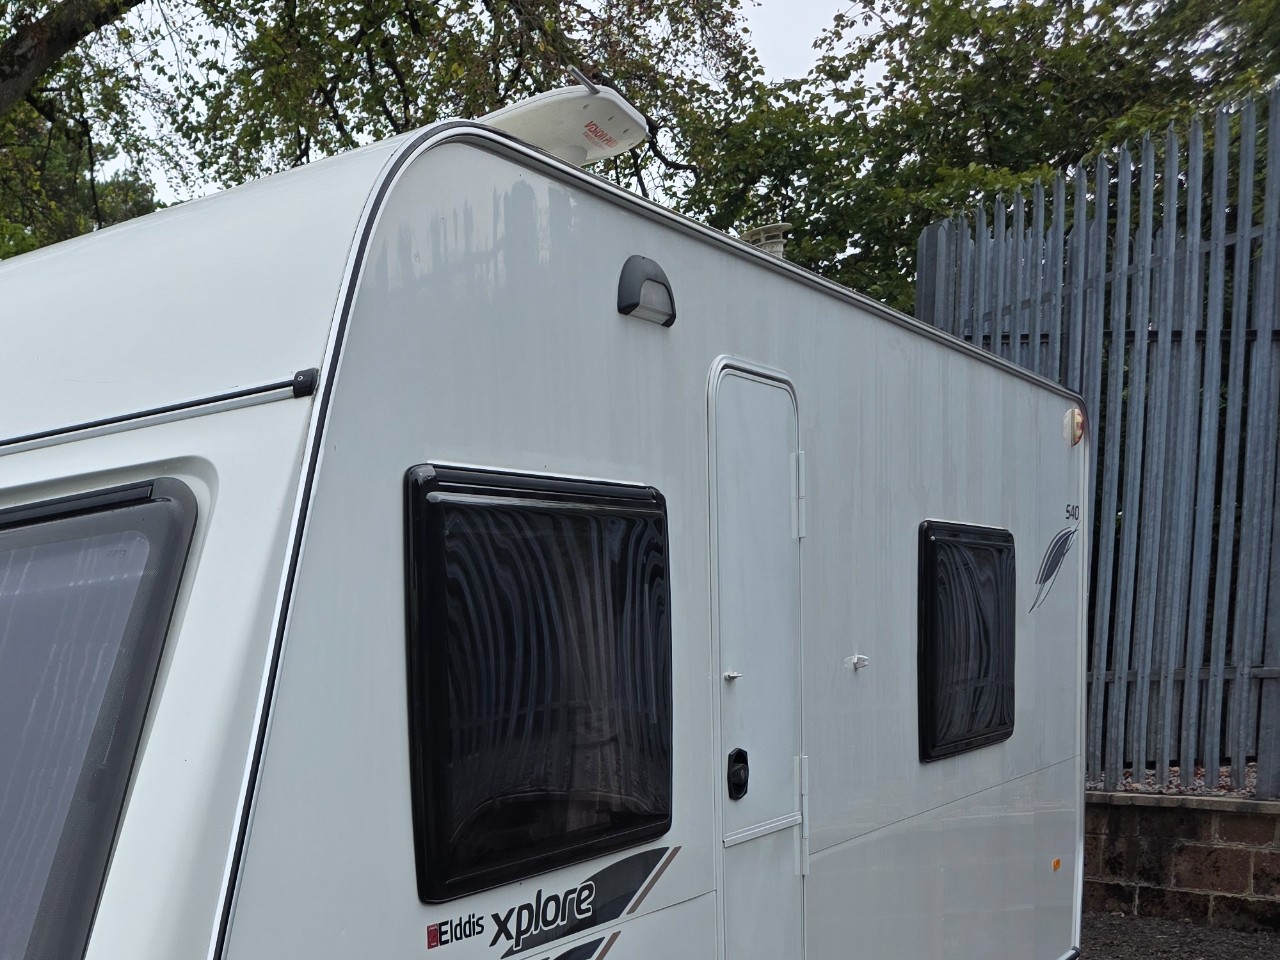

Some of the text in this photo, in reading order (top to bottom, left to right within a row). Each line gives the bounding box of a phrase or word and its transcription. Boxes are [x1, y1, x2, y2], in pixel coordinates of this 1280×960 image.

[1065, 503, 1080, 521] 540
[438, 881, 597, 950] Elddis xplore
